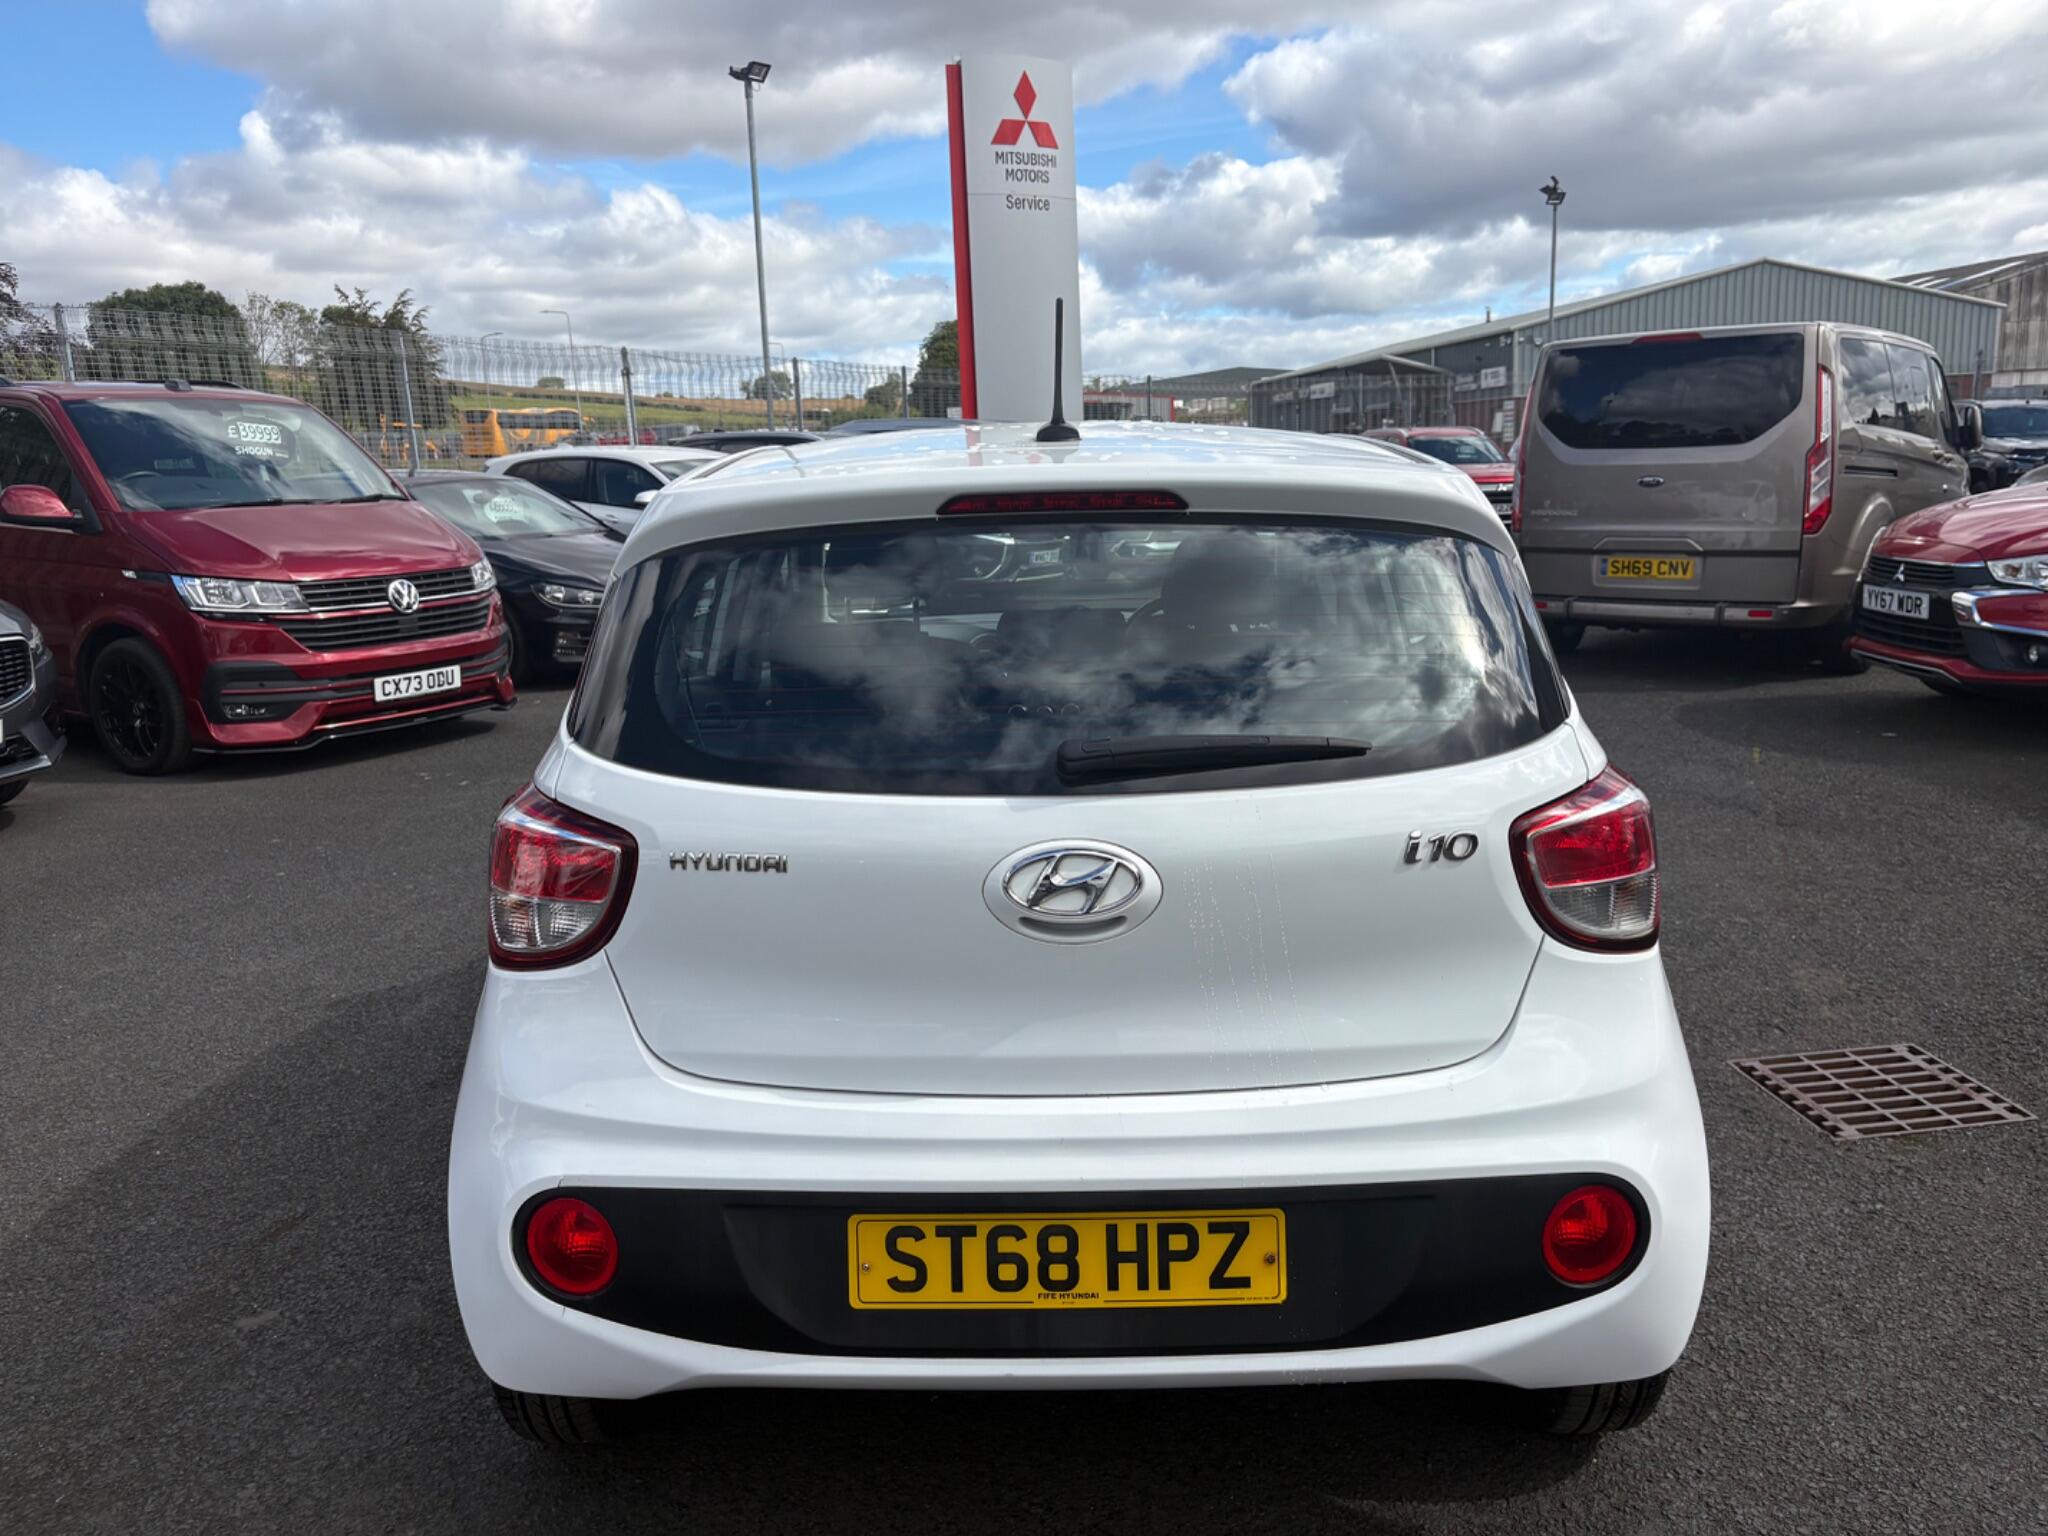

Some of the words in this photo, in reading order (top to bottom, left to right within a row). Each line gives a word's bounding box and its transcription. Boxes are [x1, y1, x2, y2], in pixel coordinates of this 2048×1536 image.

[995, 151, 1057, 168] MITSUBISHI
[1005, 168, 1049, 183] MOTORS
[1005, 194, 1050, 211] Service
[1610, 559, 1653, 576] SH69
[1656, 560, 1690, 576] CNV
[1867, 588, 1894, 611] YY67
[1897, 594, 1923, 616] WDR
[382, 675, 423, 697] CX73
[426, 669, 455, 689] ODU
[1403, 830, 1479, 865] i10
[669, 851, 789, 874] HYUNDAI
[885, 1223, 1080, 1293] ST68
[1105, 1220, 1252, 1292] HPZ
[1059, 1292, 1100, 1300] HYUNDAI
